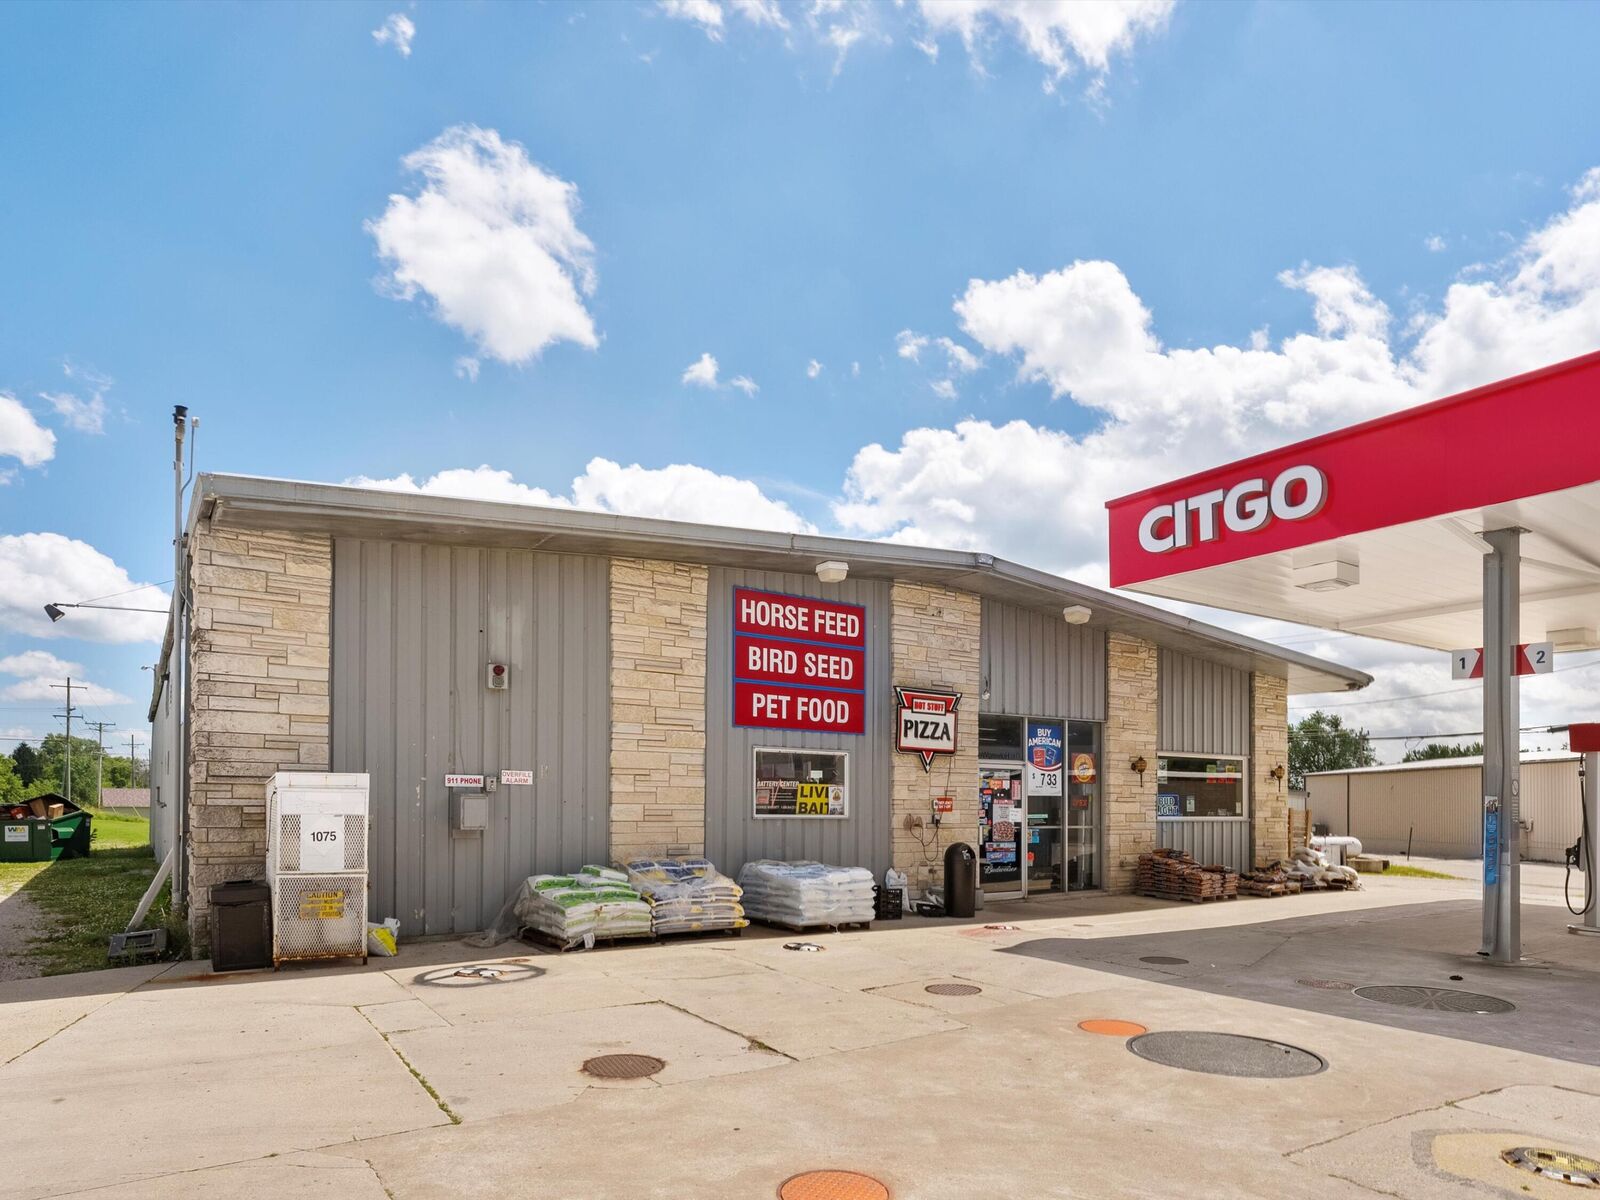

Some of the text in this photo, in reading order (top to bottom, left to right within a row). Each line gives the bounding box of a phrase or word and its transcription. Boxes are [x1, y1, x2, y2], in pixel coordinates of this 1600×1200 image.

[1138, 465, 1327, 553] CITGO
[741, 598, 860, 638] HORSE FEED
[748, 645, 854, 681] BIRD SEED
[1458, 656, 1466, 670] 1
[1536, 649, 1546, 664] 2
[752, 692, 850, 724] PET FOOD
[913, 700, 945, 712] HOT STUFF
[903, 718, 951, 742] PIZZA
[1037, 728, 1052, 737] BUY
[1028, 737, 1062, 748] AMERICAN
[1158, 796, 1174, 806] BUD
[1158, 806, 1178, 816] IGHT
[310, 831, 337, 843] 1075
[984, 863, 1017, 874] Budweiser
